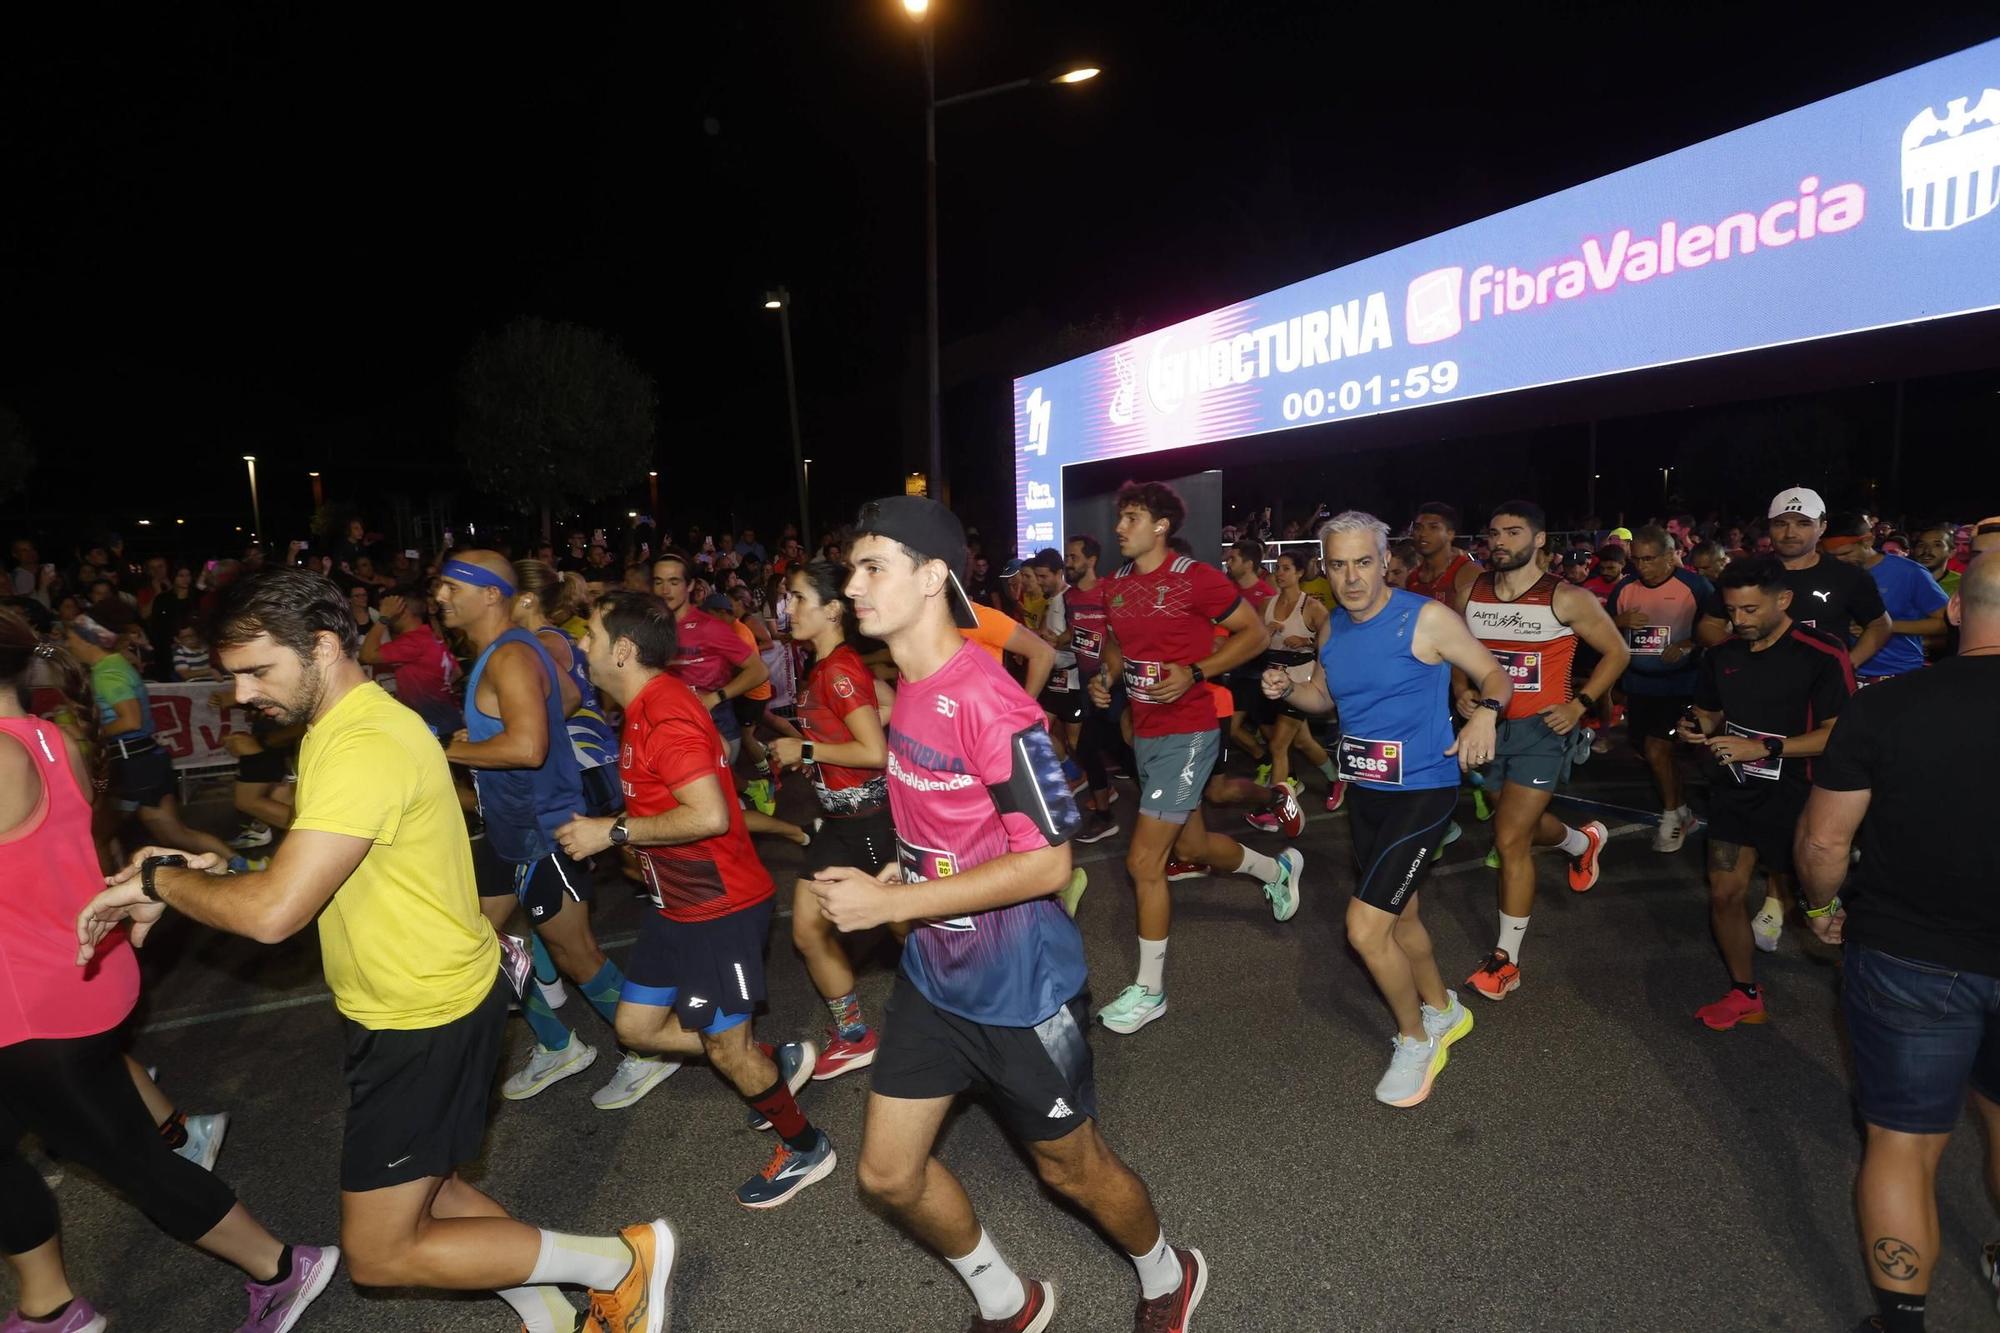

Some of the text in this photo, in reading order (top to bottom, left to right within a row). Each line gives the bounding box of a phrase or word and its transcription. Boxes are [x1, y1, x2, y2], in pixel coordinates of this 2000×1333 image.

[1468, 175, 1866, 322] fibraValencia
[1187, 290, 1394, 395] NOCTURNA
[1282, 360, 1460, 421] 00:01:59
[1346, 754, 1389, 773] 2686
[937, 860, 950, 868] SUB
